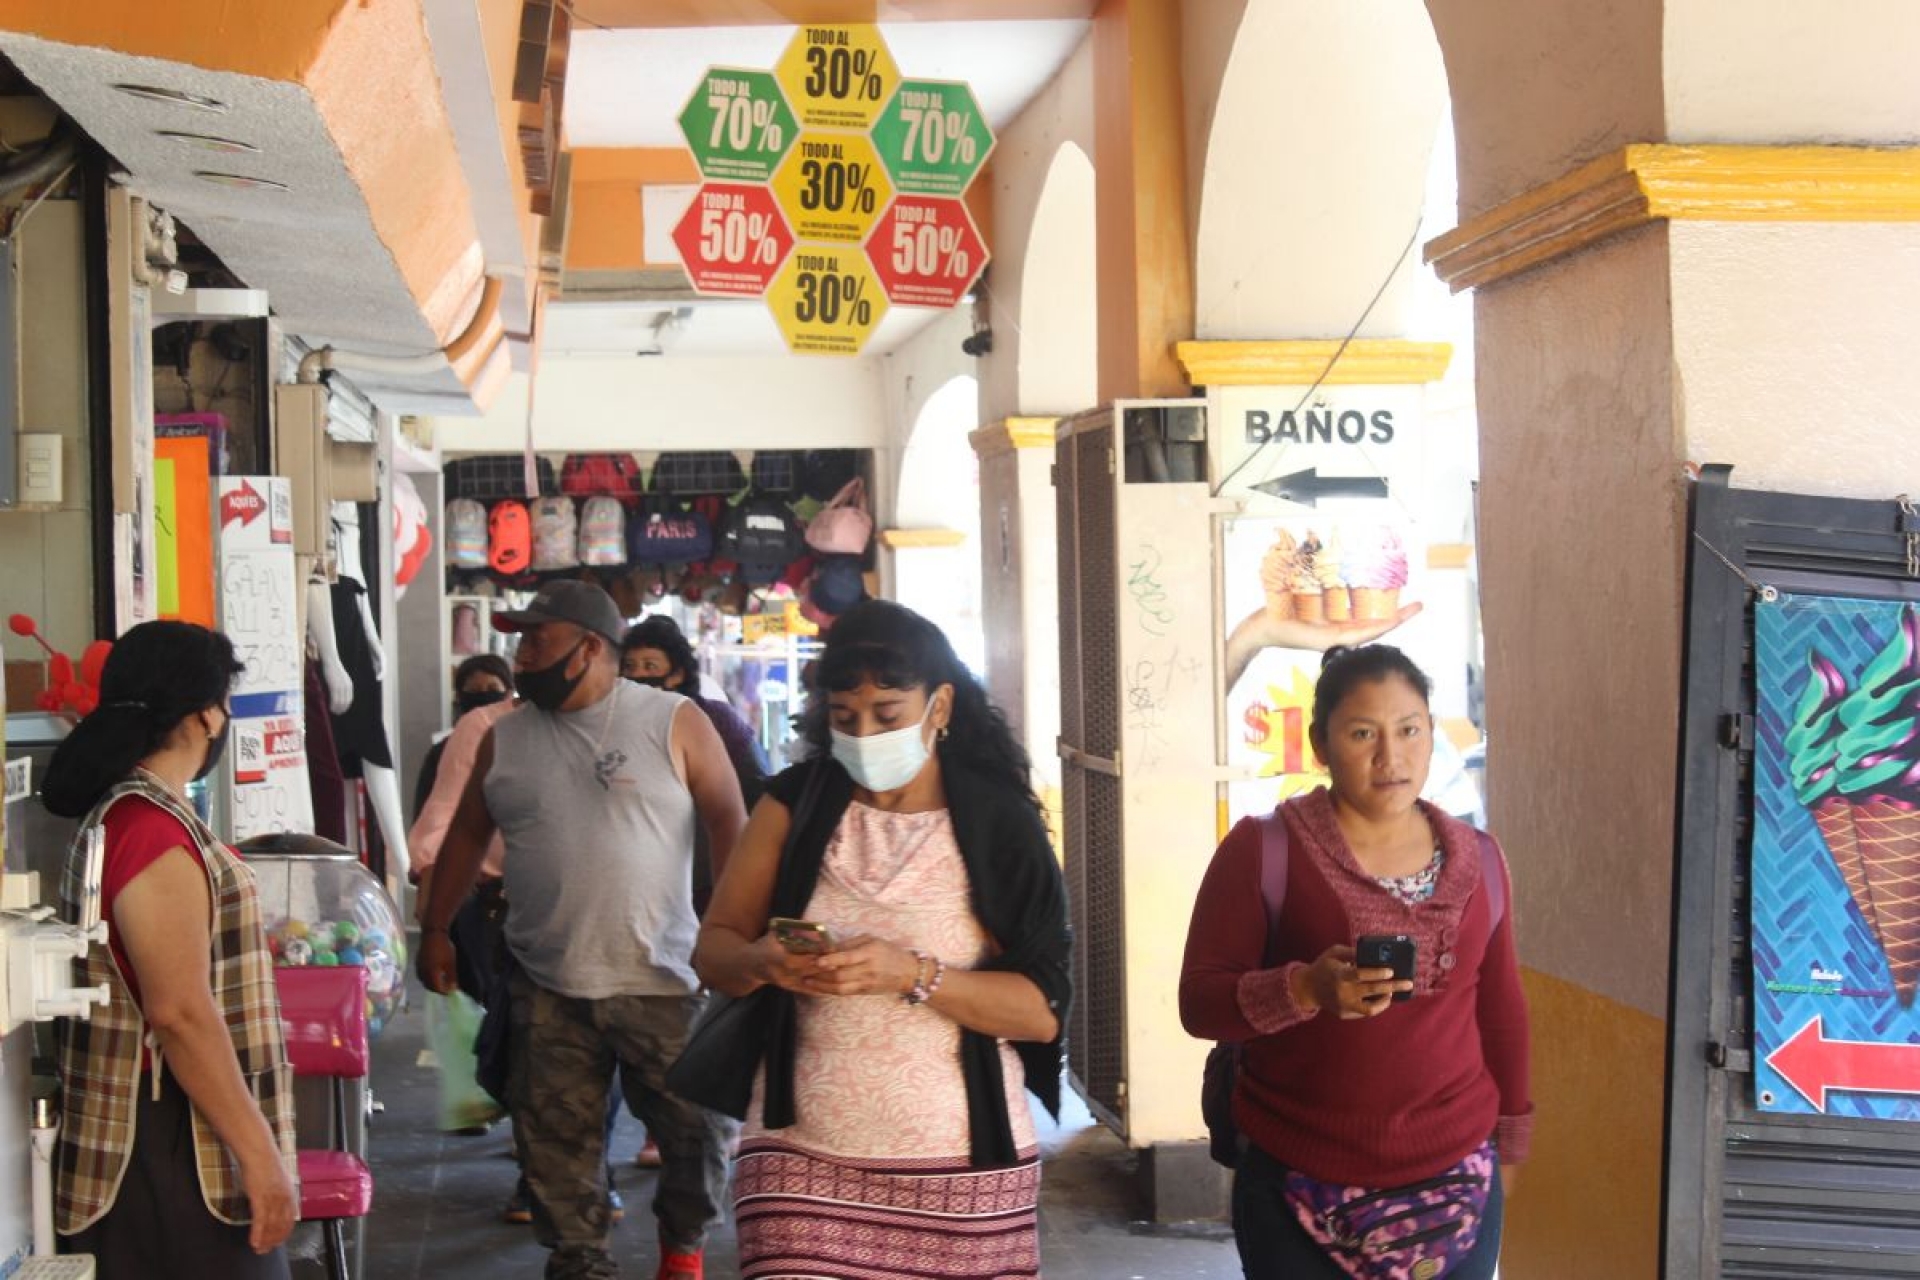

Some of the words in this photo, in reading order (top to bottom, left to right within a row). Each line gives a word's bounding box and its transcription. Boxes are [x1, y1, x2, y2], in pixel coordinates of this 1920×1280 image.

[806, 29, 835, 45] TODO
[837, 30, 850, 46] AL
[708, 78, 736, 96] TODO
[738, 80, 750, 97] AL
[805, 46, 881, 101] 30%
[900, 90, 929, 108] TODO
[930, 92, 943, 109] AL
[707, 96, 782, 152] 70%
[900, 108, 976, 165] 70%
[801, 142, 830, 158] TODO
[831, 143, 844, 160] AL
[702, 192, 731, 209] TODO
[732, 193, 745, 210] AL
[800, 160, 875, 214] 30%
[895, 204, 925, 222] TODO
[925, 206, 937, 224] AL
[699, 210, 778, 265] 50%
[892, 223, 969, 279] 50%
[796, 255, 825, 271] TODO
[826, 256, 839, 272] AL
[795, 272, 871, 326] 30%
[1245, 402, 1395, 445] BAÑOS
[646, 520, 697, 539] PARIS
[1244, 699, 1329, 776] $1
